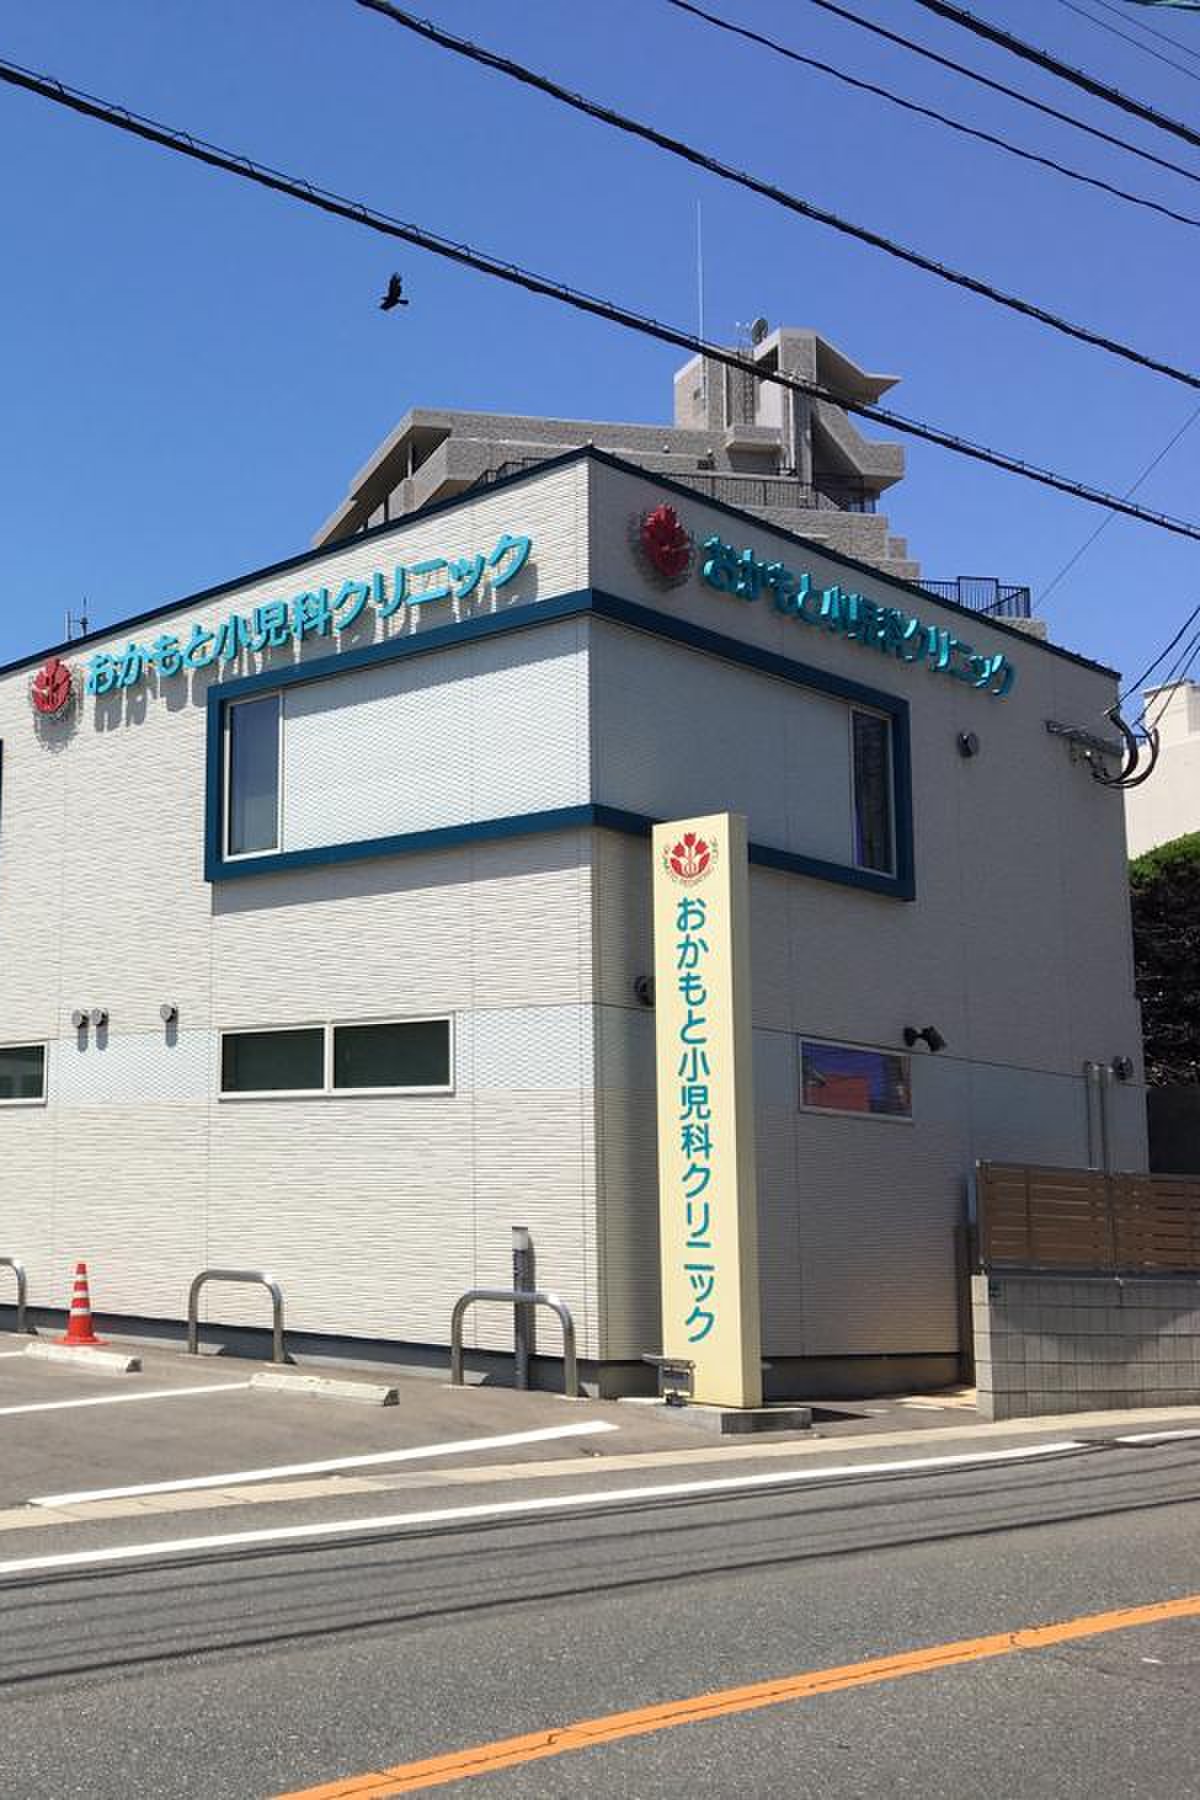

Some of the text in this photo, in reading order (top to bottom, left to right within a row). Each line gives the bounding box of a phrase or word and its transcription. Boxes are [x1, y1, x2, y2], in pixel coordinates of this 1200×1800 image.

[84, 533, 533, 696] おかもと小児科クリニック
[676, 896, 715, 1343] おかもと小児科クリニック
